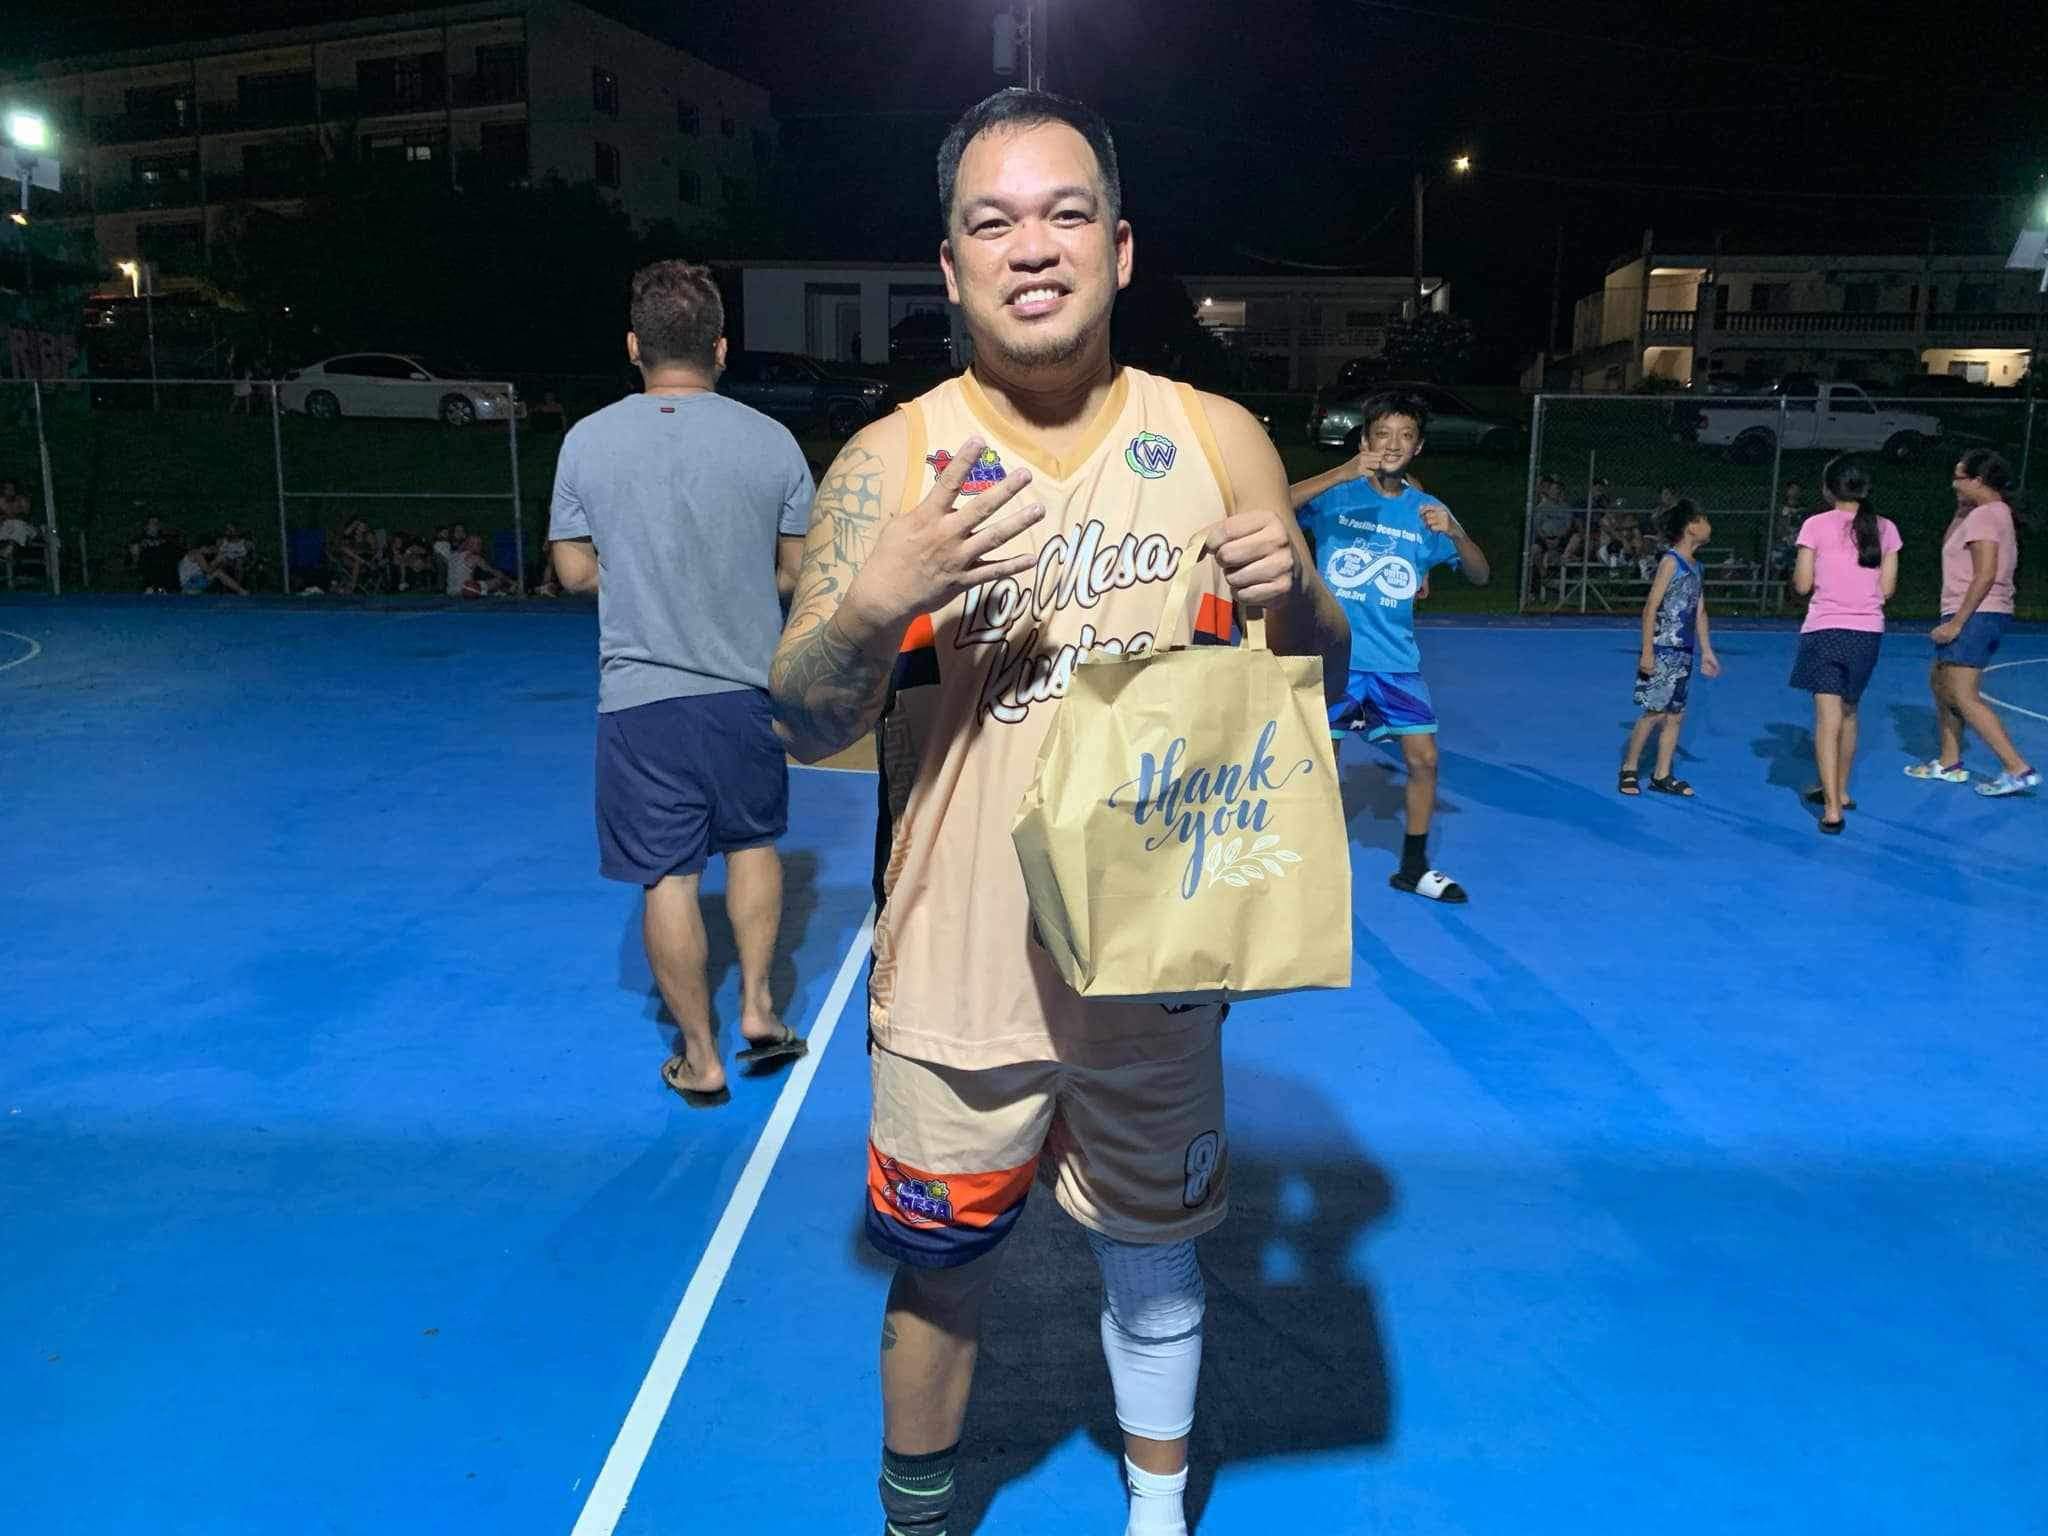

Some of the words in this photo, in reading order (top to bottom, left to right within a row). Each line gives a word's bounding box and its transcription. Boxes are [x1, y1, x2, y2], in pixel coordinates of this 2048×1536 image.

[1031, 519, 1184, 623] Mesa
[1108, 719, 1314, 827] thank
[1145, 796, 1276, 902] you
